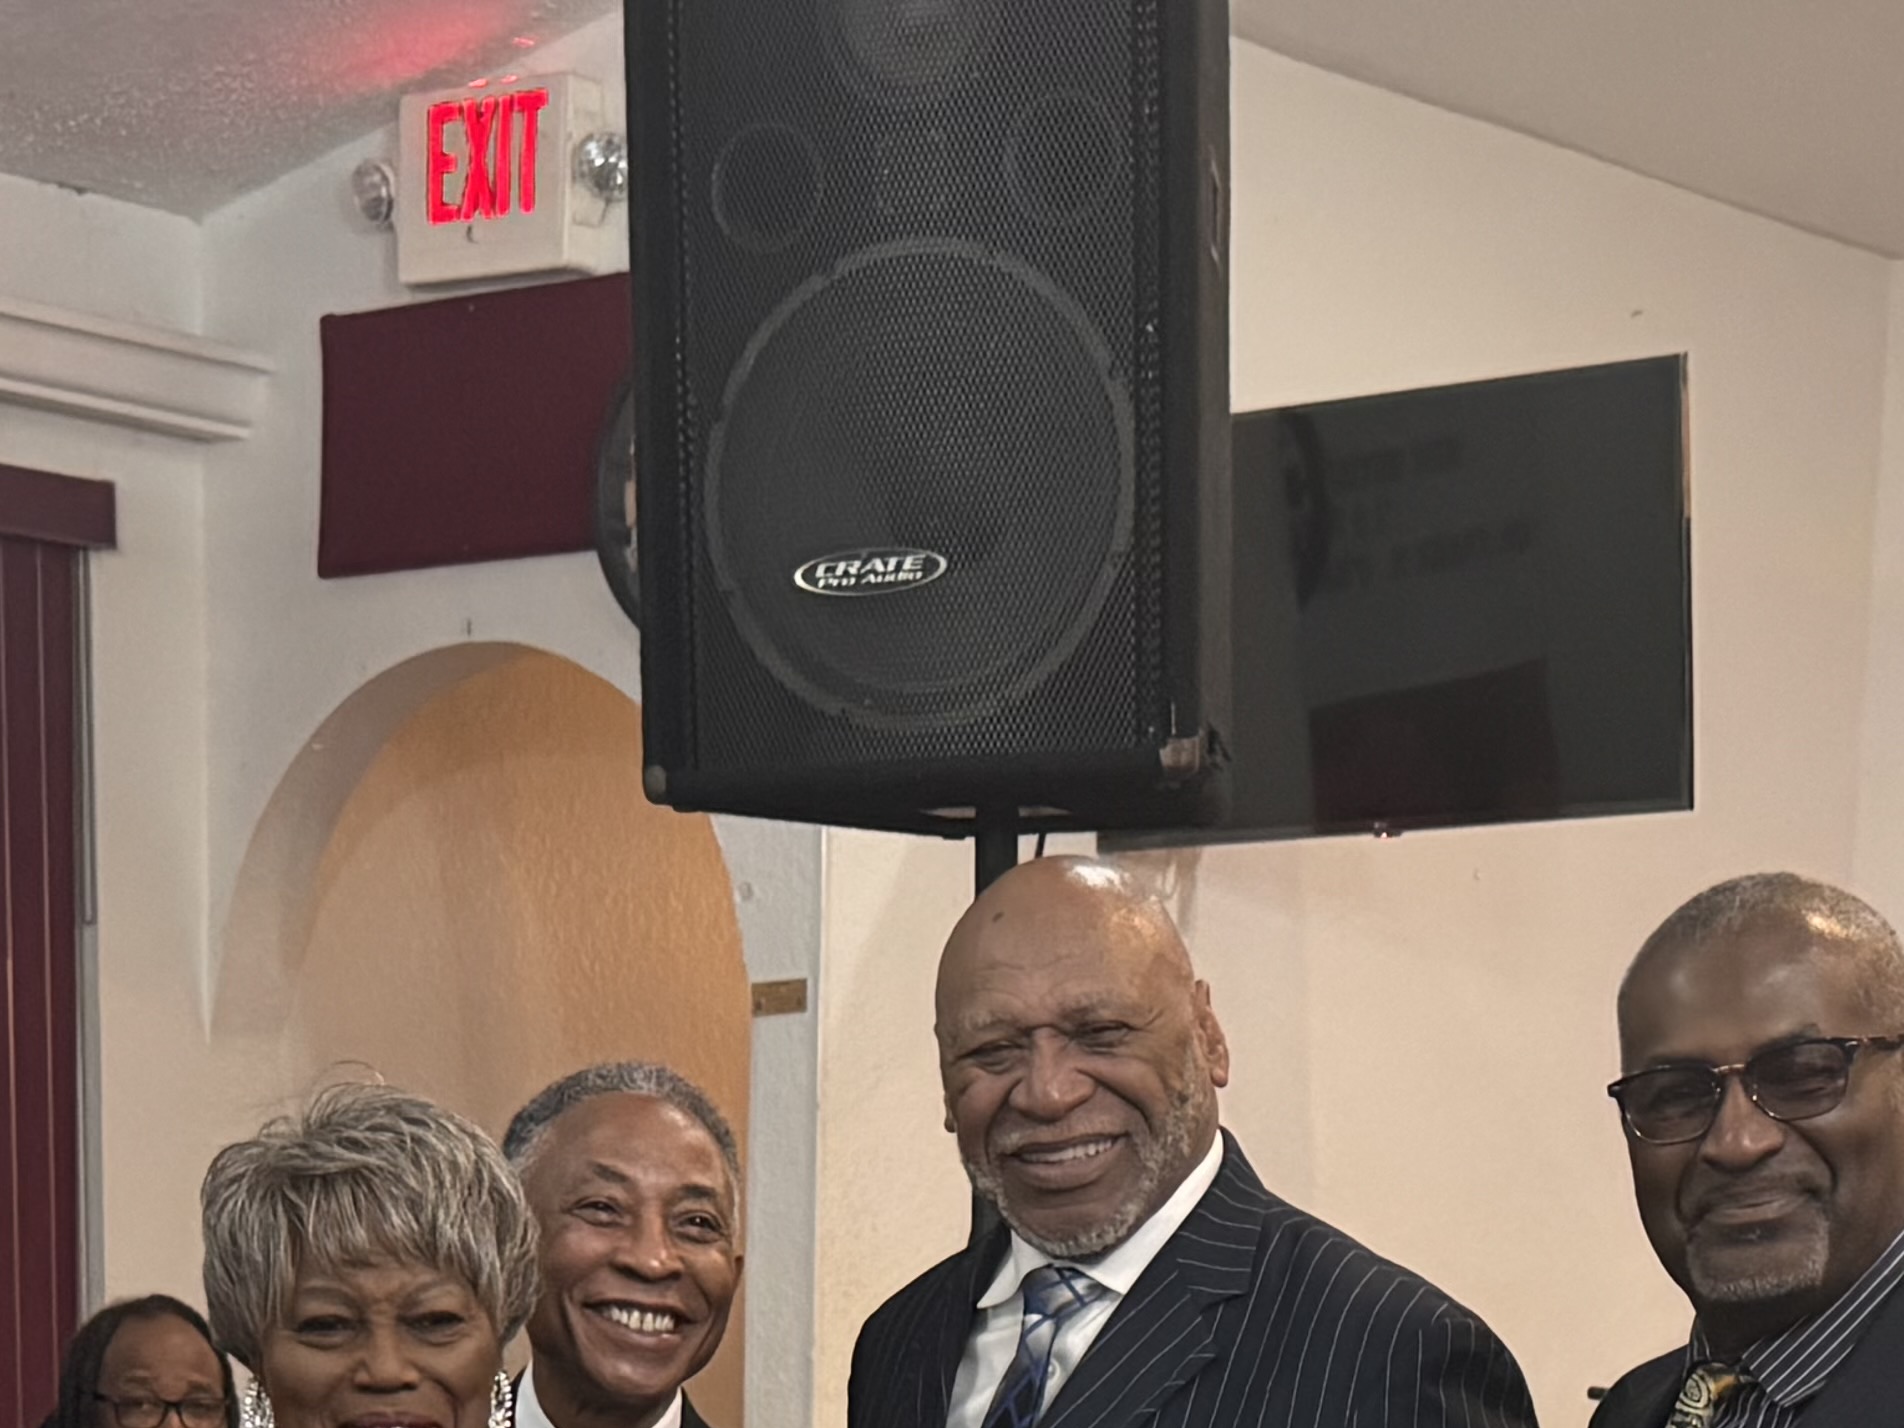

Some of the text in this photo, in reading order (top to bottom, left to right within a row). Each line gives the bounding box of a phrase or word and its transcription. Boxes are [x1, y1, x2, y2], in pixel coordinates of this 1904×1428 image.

[426, 87, 549, 225] EXIT
[815, 554, 927, 578] CRATE
[817, 571, 924, 589] Pro Audio
